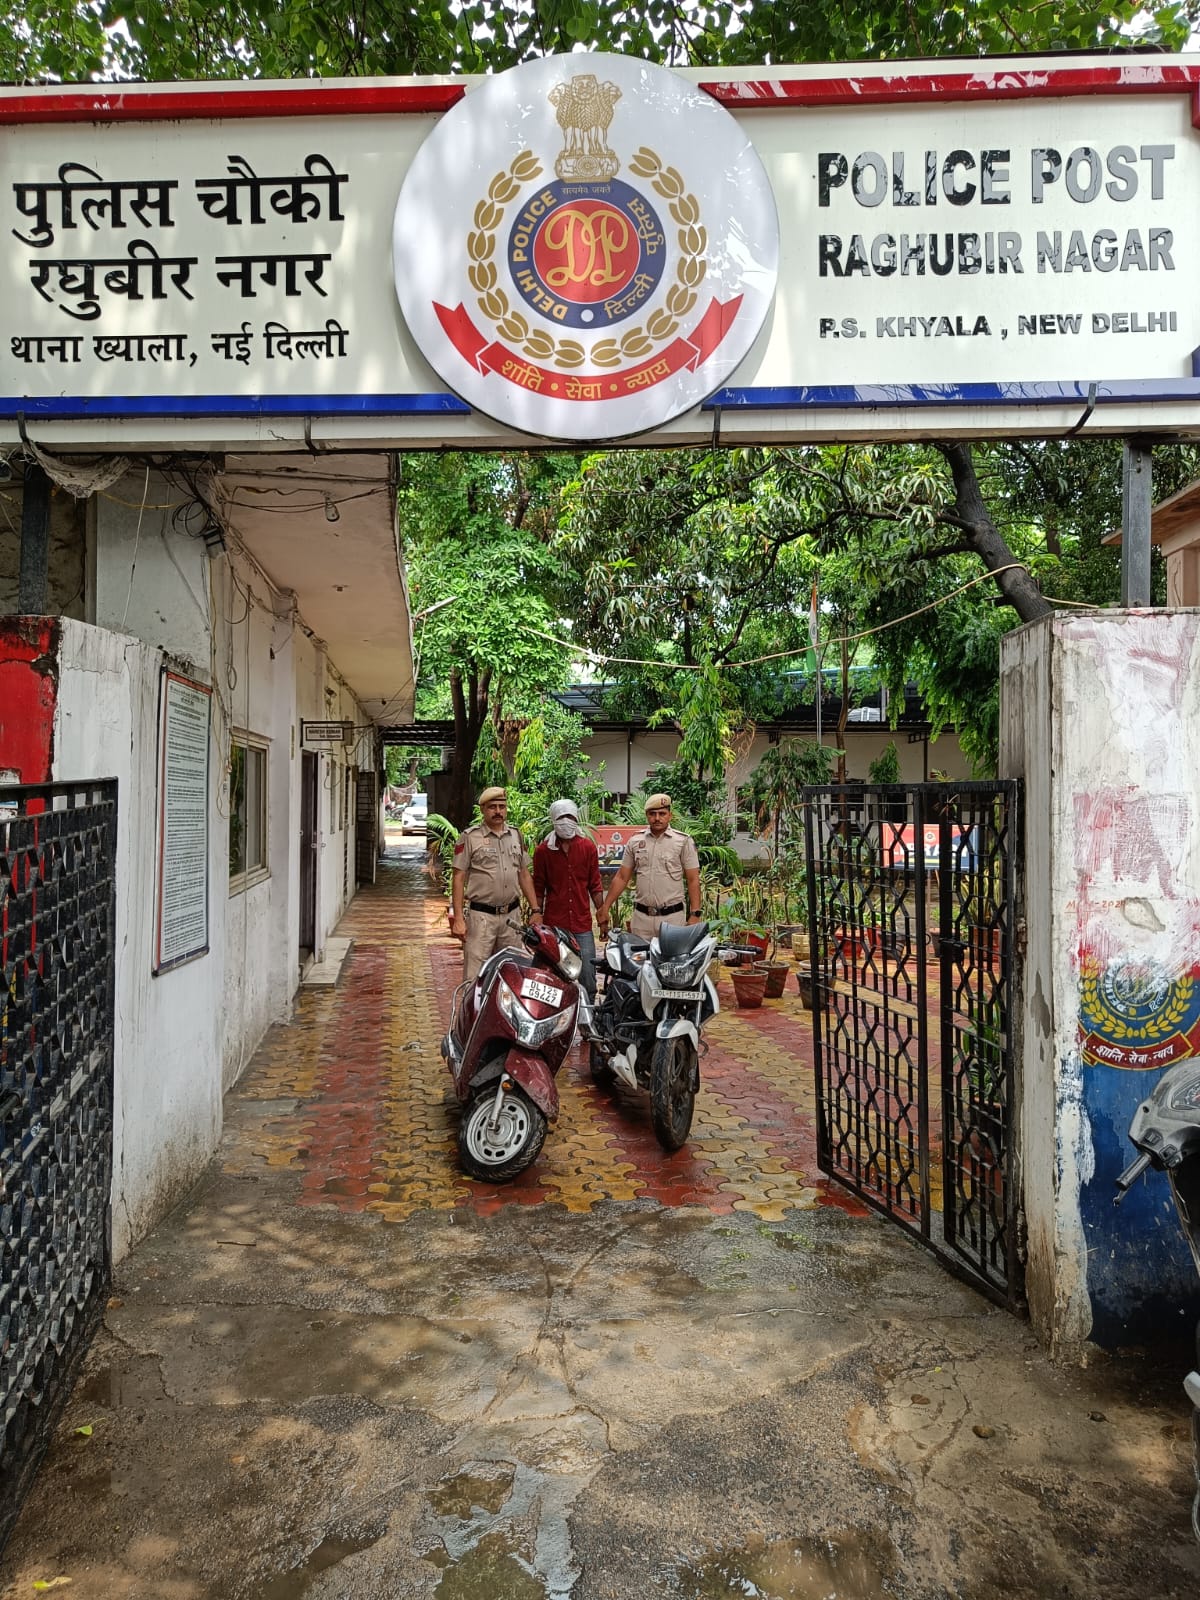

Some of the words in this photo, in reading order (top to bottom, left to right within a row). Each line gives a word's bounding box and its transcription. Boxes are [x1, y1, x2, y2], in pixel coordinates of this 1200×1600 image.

[12, 163, 178, 248] पुलिस
[195, 154, 348, 225] चौकी
[818, 149, 1011, 208] POLICE
[1031, 145, 1174, 204] POST
[513, 190, 557, 262] POLICE
[819, 232, 1024, 277] RAGHUBIR
[1037, 228, 1175, 273] NAGAR
[29, 239, 198, 320] रघुबीर
[215, 254, 331, 297] नगर
[516, 268, 569, 320] DELHI
[604, 273, 655, 319] दिल्ली
[11, 337, 83, 362] थाना
[211, 322, 253, 365] नई
[263, 319, 349, 360] दिल्ली
[820, 318, 866, 338] P.S.
[1018, 314, 1082, 335] NEW
[1092, 312, 1177, 333] DELHI
[501, 359, 544, 391] शांति
[565, 376, 602, 399] सेवा
[624, 358, 671, 390] न्याय
